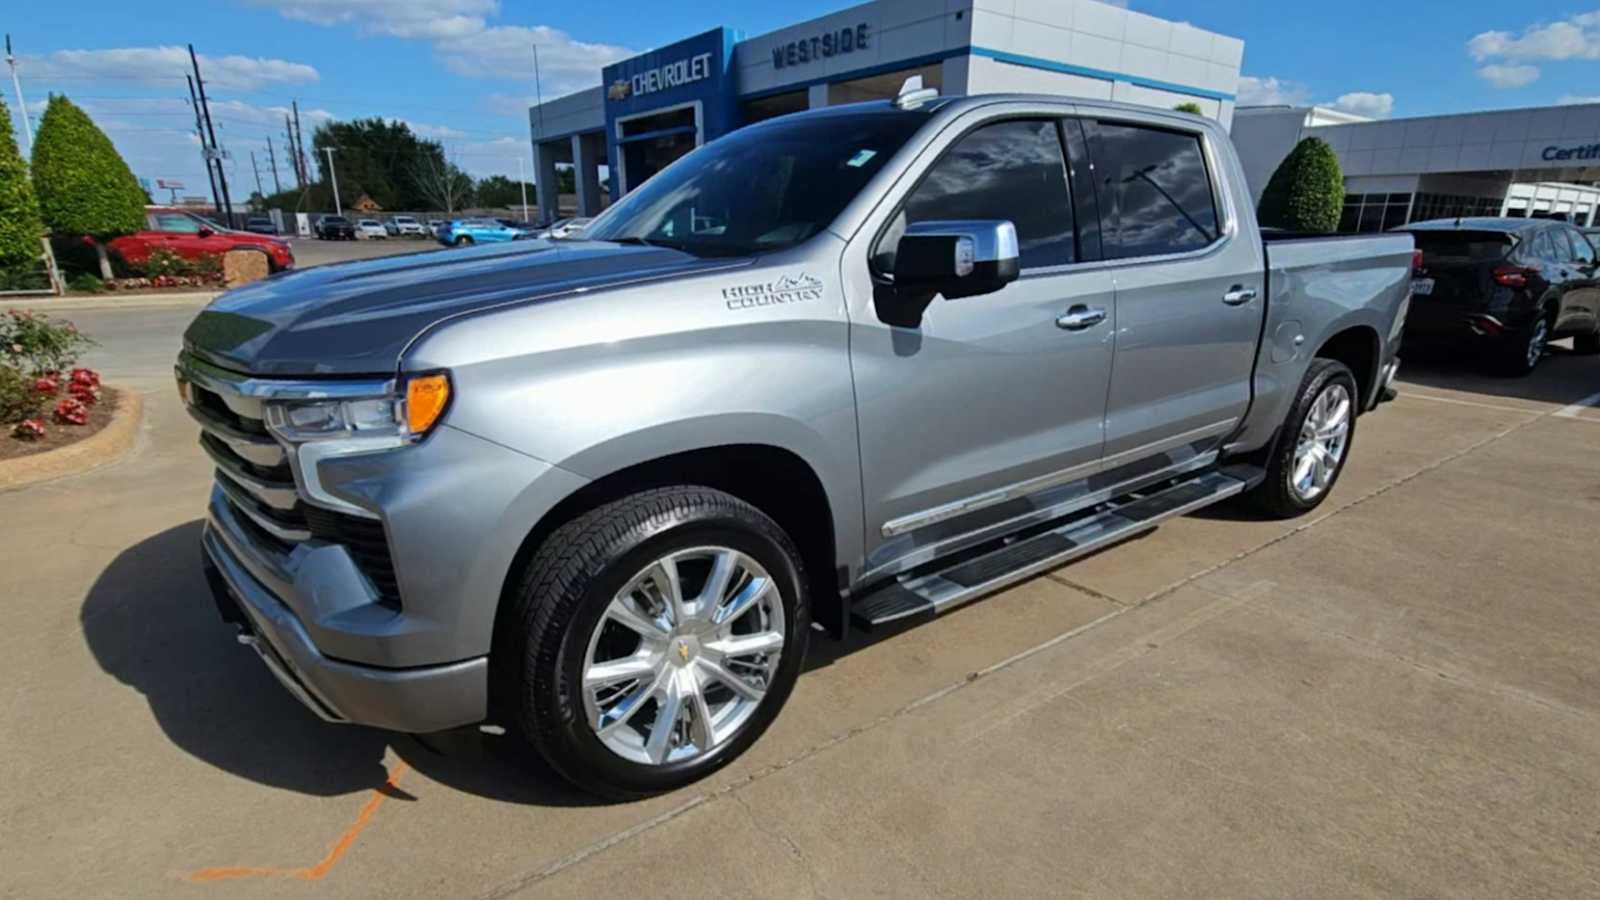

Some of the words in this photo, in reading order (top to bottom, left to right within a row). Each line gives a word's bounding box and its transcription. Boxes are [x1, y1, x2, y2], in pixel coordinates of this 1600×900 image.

[772, 23, 869, 70] WESTSIDE
[631, 52, 711, 96] CHEVROLET
[722, 283, 773, 299] HIGH
[726, 288, 823, 310] COUNTRY
